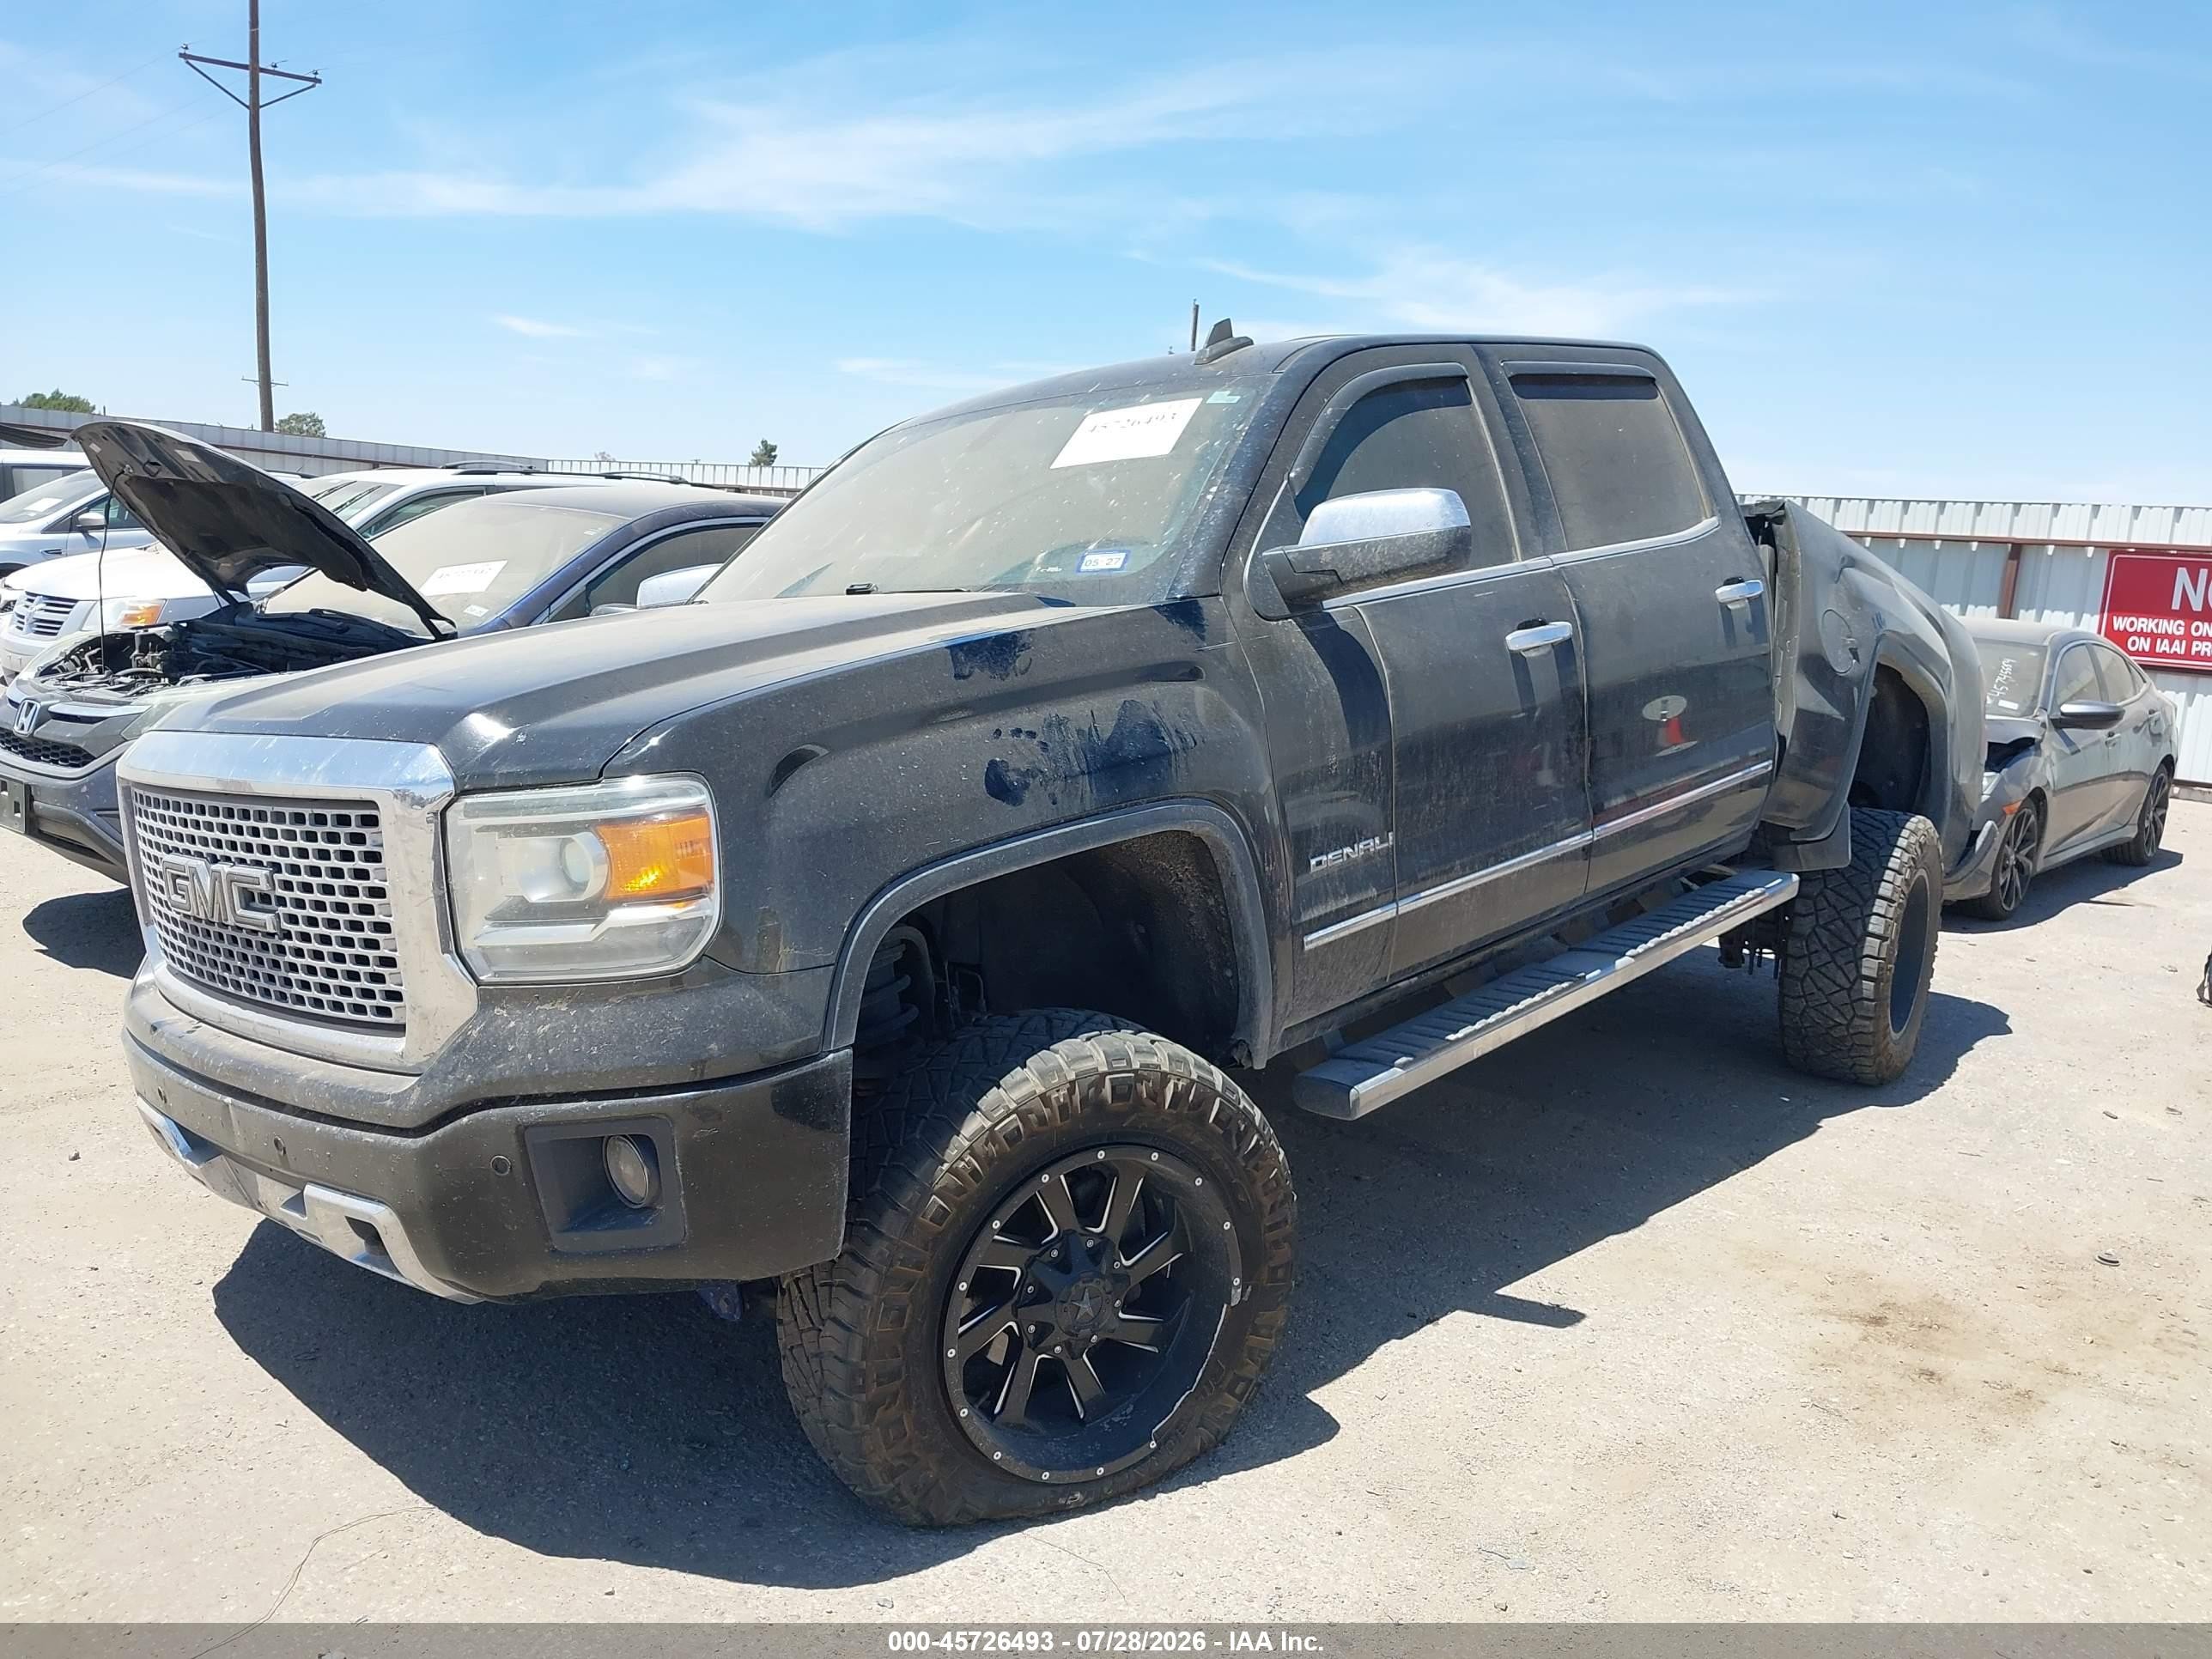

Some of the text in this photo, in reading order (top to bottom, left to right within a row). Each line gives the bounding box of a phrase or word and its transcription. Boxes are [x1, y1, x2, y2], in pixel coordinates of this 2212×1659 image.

[1105, 556, 1121, 566] 27
[2171, 567, 2212, 612] N
[2112, 616, 2185, 636] WORKING
[2127, 635, 2151, 653] ON
[2155, 637, 2186, 655] IAAI
[1310, 830, 1394, 872] DENALI
[161, 854, 282, 934] GMC
